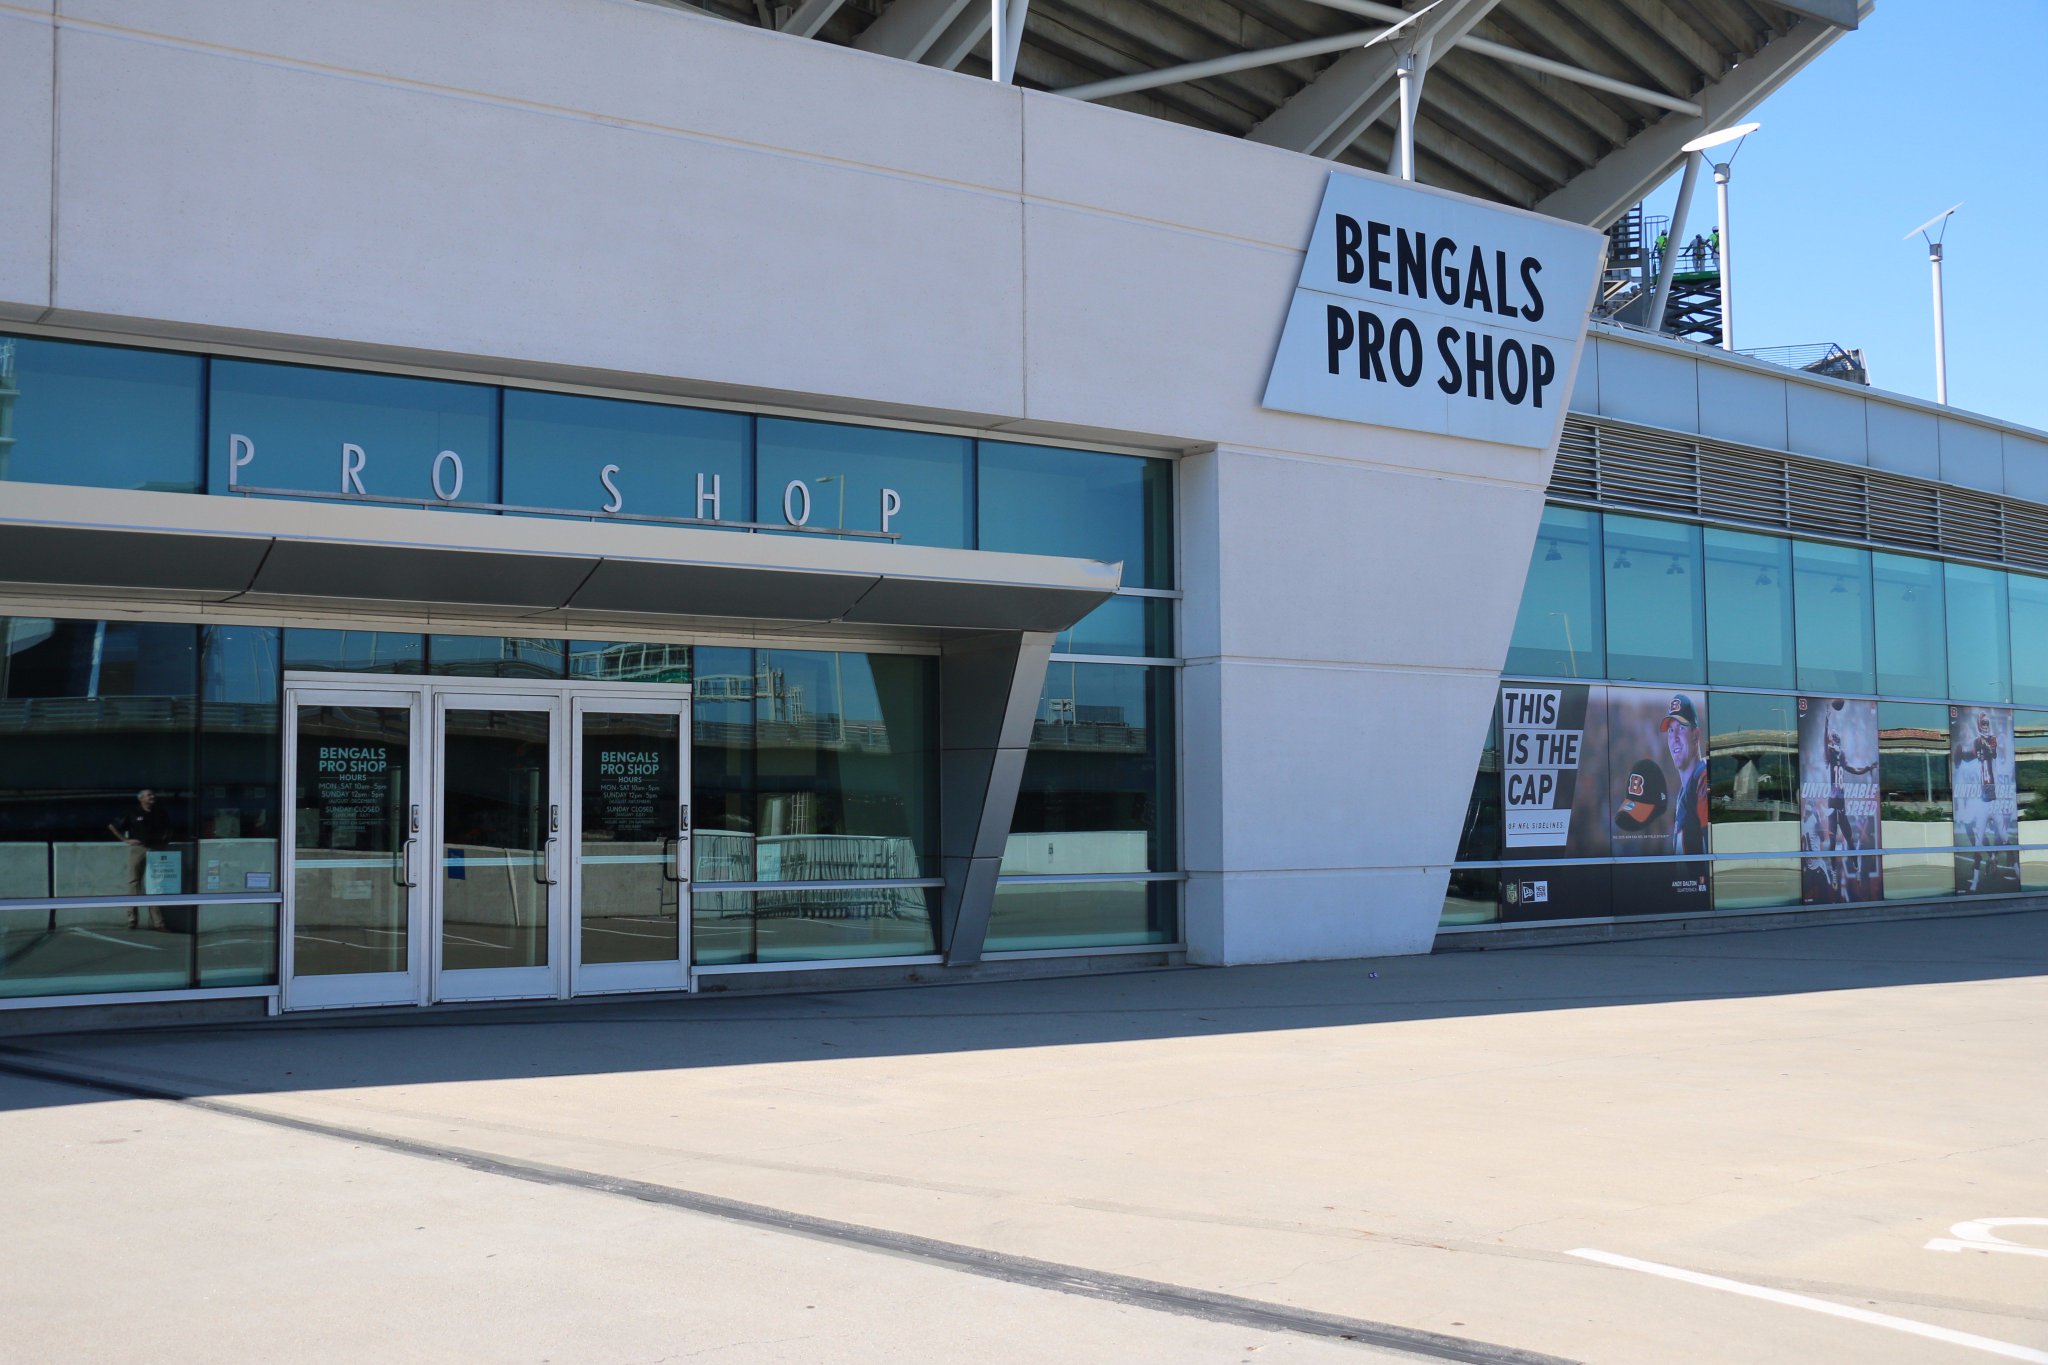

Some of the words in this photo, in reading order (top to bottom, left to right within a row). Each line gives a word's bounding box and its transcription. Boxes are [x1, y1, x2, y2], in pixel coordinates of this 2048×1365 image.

[1335, 213, 1545, 323] BENGALS
[1326, 304, 1424, 388] PRO
[1437, 326, 1555, 408] SHOP
[229, 433, 464, 501] PRO
[601, 464, 901, 533] SHOP
[1505, 692, 1556, 725] THIS
[319, 747, 386, 760] BENGALS
[601, 751, 659, 763] BENGALS
[1507, 733, 1529, 765] IS
[1535, 734, 1579, 765] THE
[319, 760, 347, 772] PRO
[350, 760, 387, 773] SHOP
[600, 763, 625, 775] PRO
[627, 763, 660, 775] SHOP
[319, 782, 337, 790] MON
[1507, 774, 1553, 806] CAP
[1845, 800, 1878, 816] SPEED
